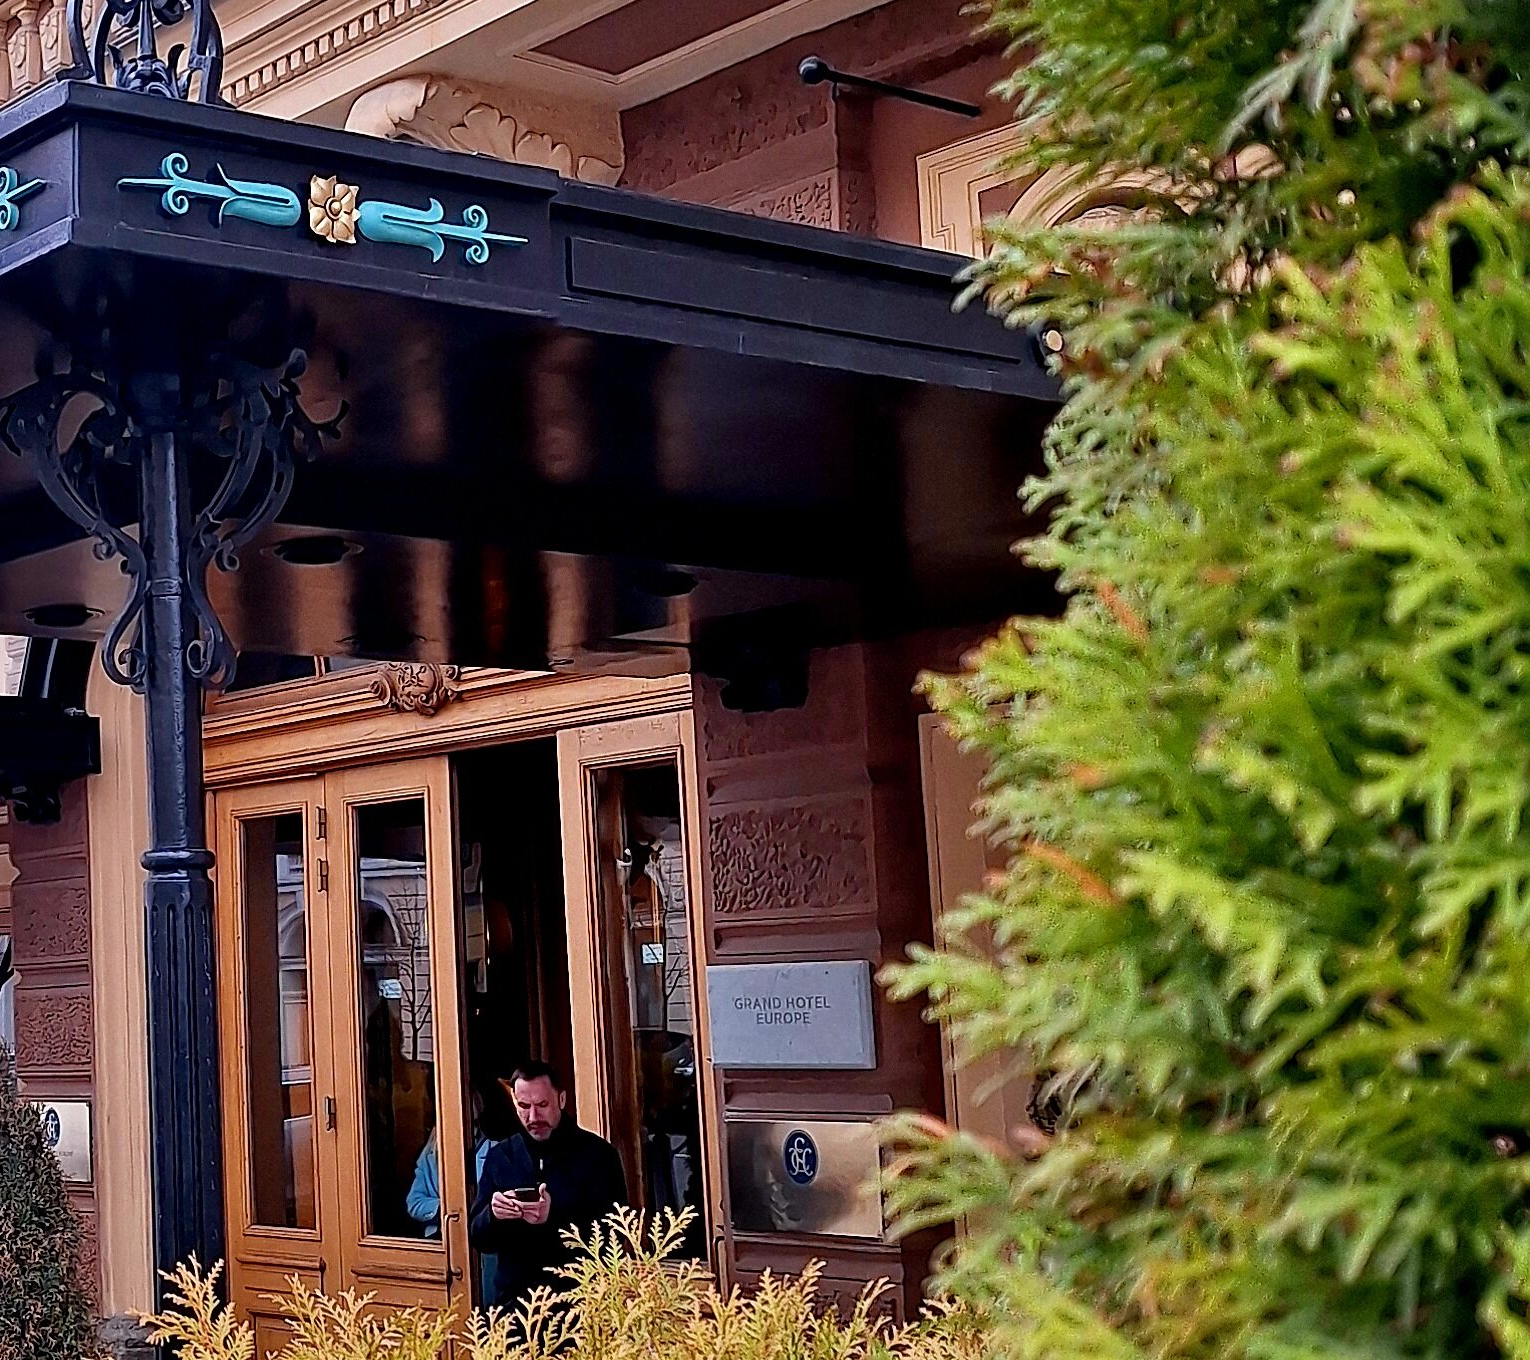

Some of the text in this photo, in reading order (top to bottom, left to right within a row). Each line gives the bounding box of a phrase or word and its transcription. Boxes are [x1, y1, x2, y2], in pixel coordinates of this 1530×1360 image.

[733, 995, 831, 1011] GRAND HOTEL
[756, 1011, 811, 1025] EUROPE
